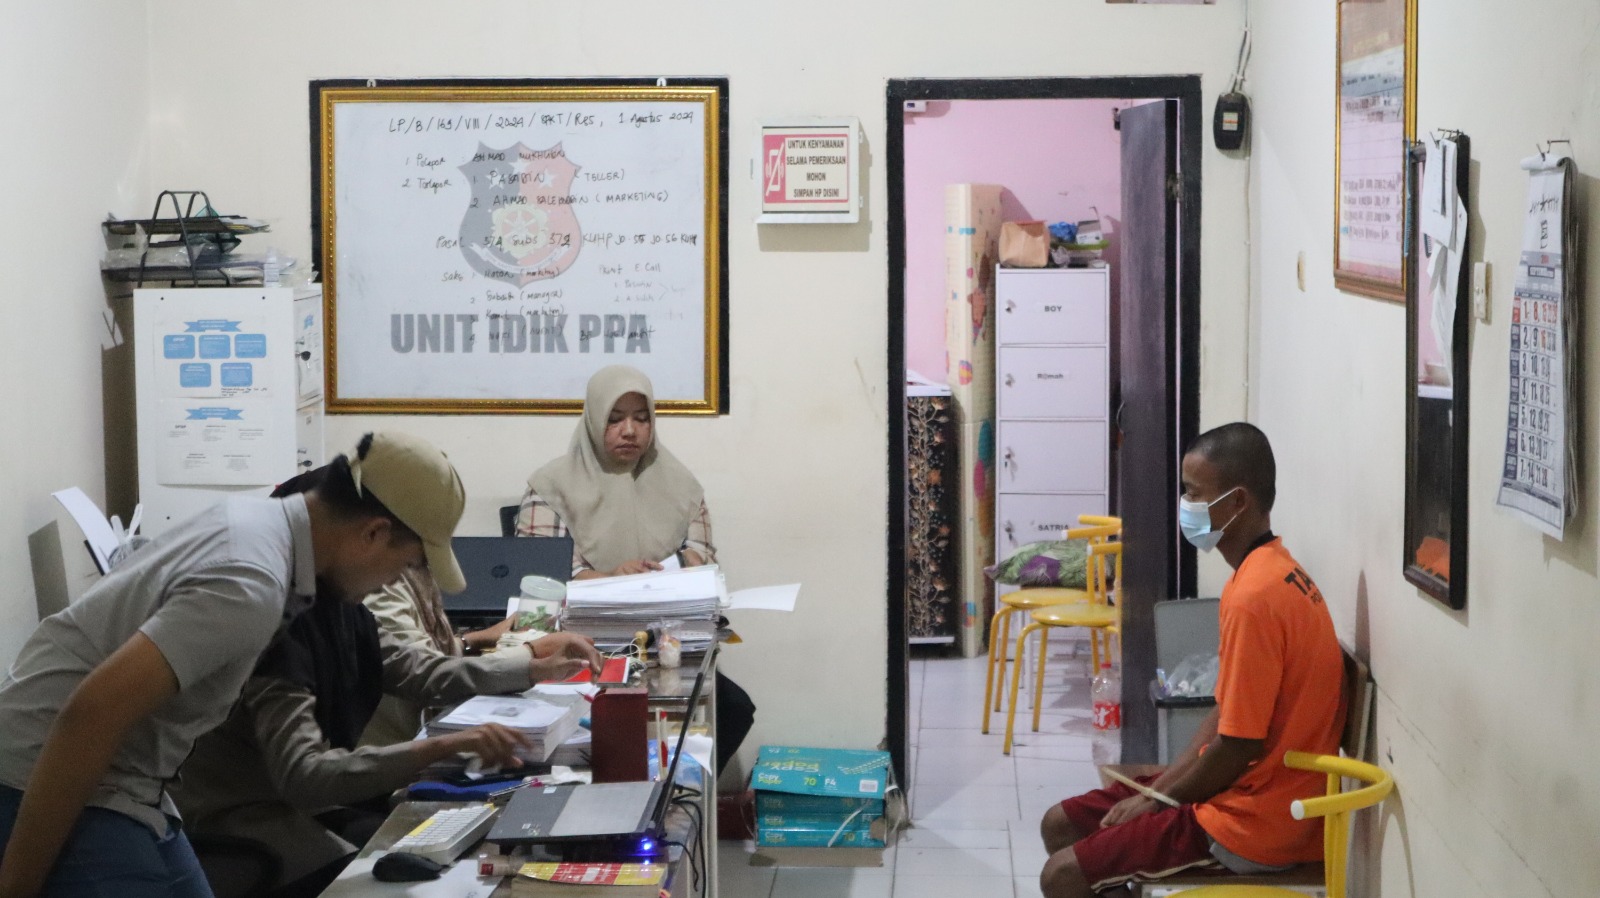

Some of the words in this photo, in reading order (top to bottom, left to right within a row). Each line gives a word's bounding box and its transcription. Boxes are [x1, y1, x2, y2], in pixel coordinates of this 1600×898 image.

[788, 140, 806, 149] UNTUK
[808, 140, 844, 149] KENYAMANAN
[787, 156, 808, 165] SELAMA
[809, 156, 846, 165] PEMERIKSAAN
[806, 172, 826, 181] MOHON
[794, 189, 814, 198] SIMPAN
[815, 189, 822, 197] HP
[823, 189, 839, 197] DISINI
[390, 314, 479, 353] UNIT
[489, 314, 569, 353] IDIK
[579, 314, 650, 353] PPA
[804, 776, 817, 787] 70
[824, 778, 837, 786] F4
